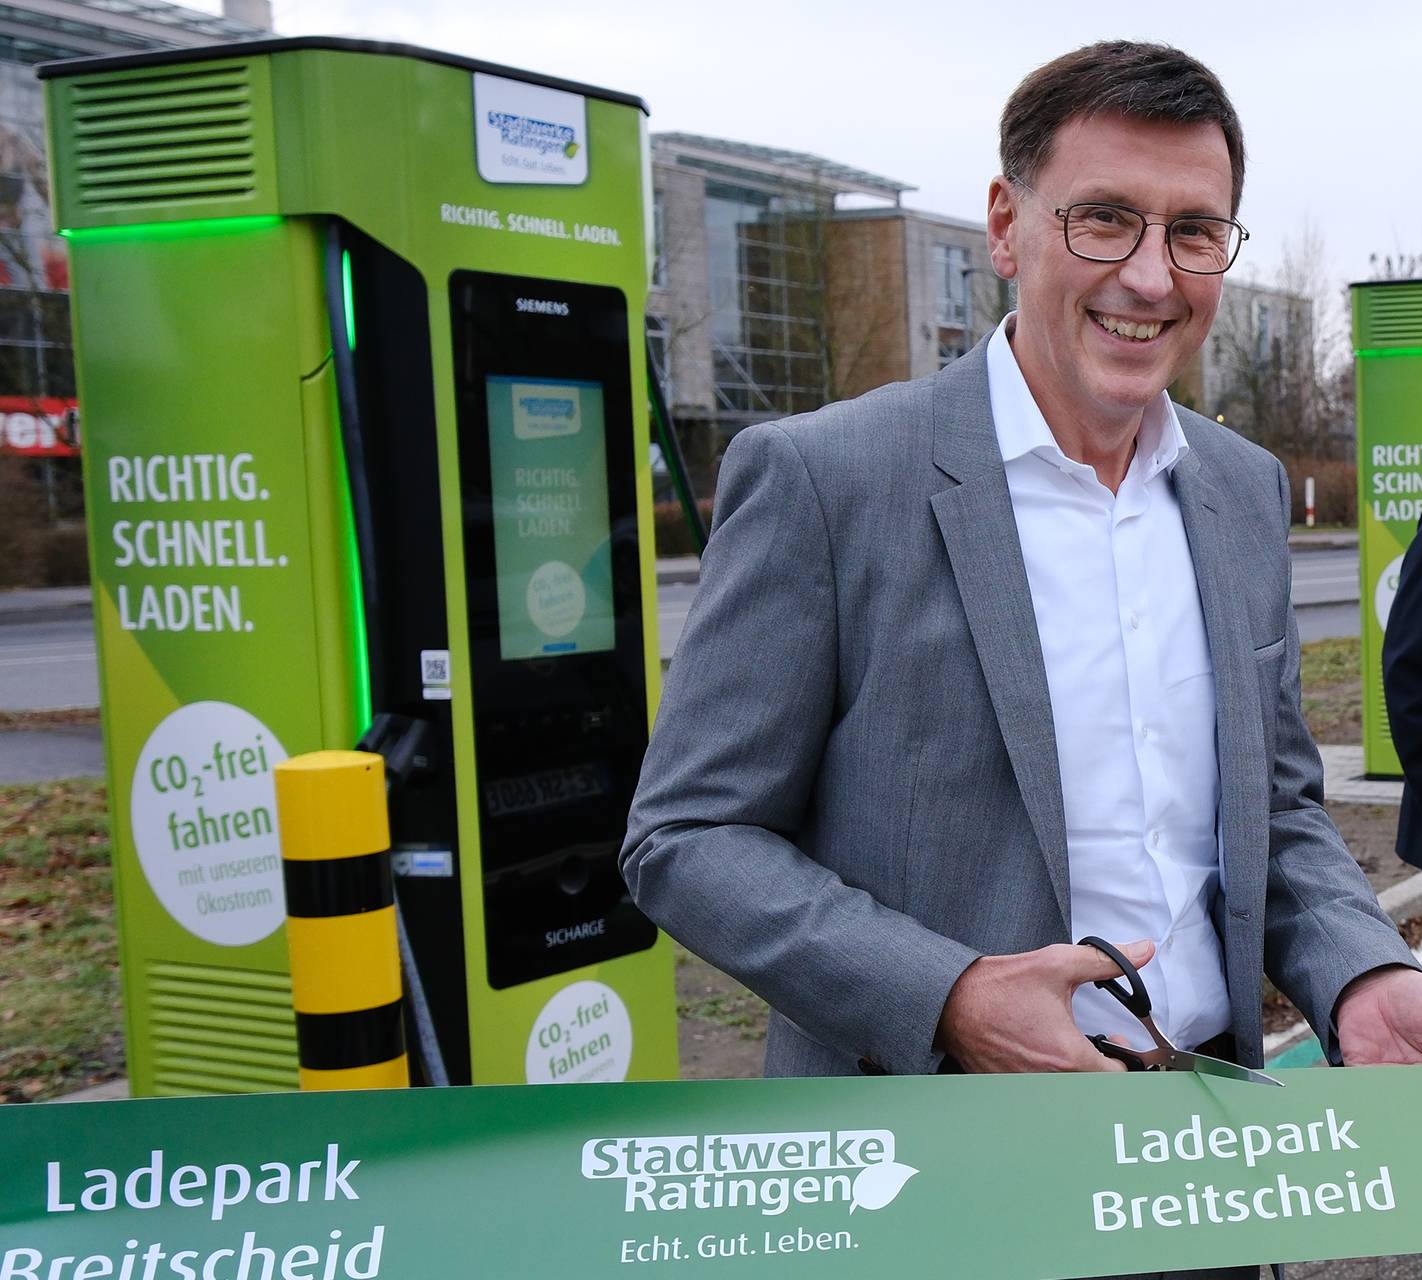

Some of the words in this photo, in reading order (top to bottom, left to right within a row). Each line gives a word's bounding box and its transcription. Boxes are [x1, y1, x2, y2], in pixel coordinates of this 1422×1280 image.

[440, 203, 504, 230] RICHTIG.
[507, 213, 571, 240] SCHNELL.
[574, 223, 622, 247] LADEN.
[515, 297, 570, 317] SIEMENS
[108, 453, 270, 502] RICHTIG.
[112, 519, 288, 567] SCHNELL.
[117, 584, 254, 632] LADEN.
[167, 806, 273, 851] fahren
[178, 864, 205, 886] mit
[209, 853, 280, 882] unserem
[196, 887, 273, 916] Ökostrom
[545, 918, 606, 948] SICHARGE
[548, 1032, 612, 1079] fahren
[591, 1130, 886, 1177] Stadtwerke
[1113, 1108, 1361, 1167] Ladepark
[47, 1143, 361, 1221] Ladepark
[625, 1172, 851, 1216] Ratingen
[1092, 1166, 1397, 1232] Breitscheid
[0, 1226, 385, 1280] Breitscheid
[620, 1236, 690, 1264] Echt.
[697, 1233, 757, 1259] Gut.
[764, 1227, 859, 1255] Leben.
